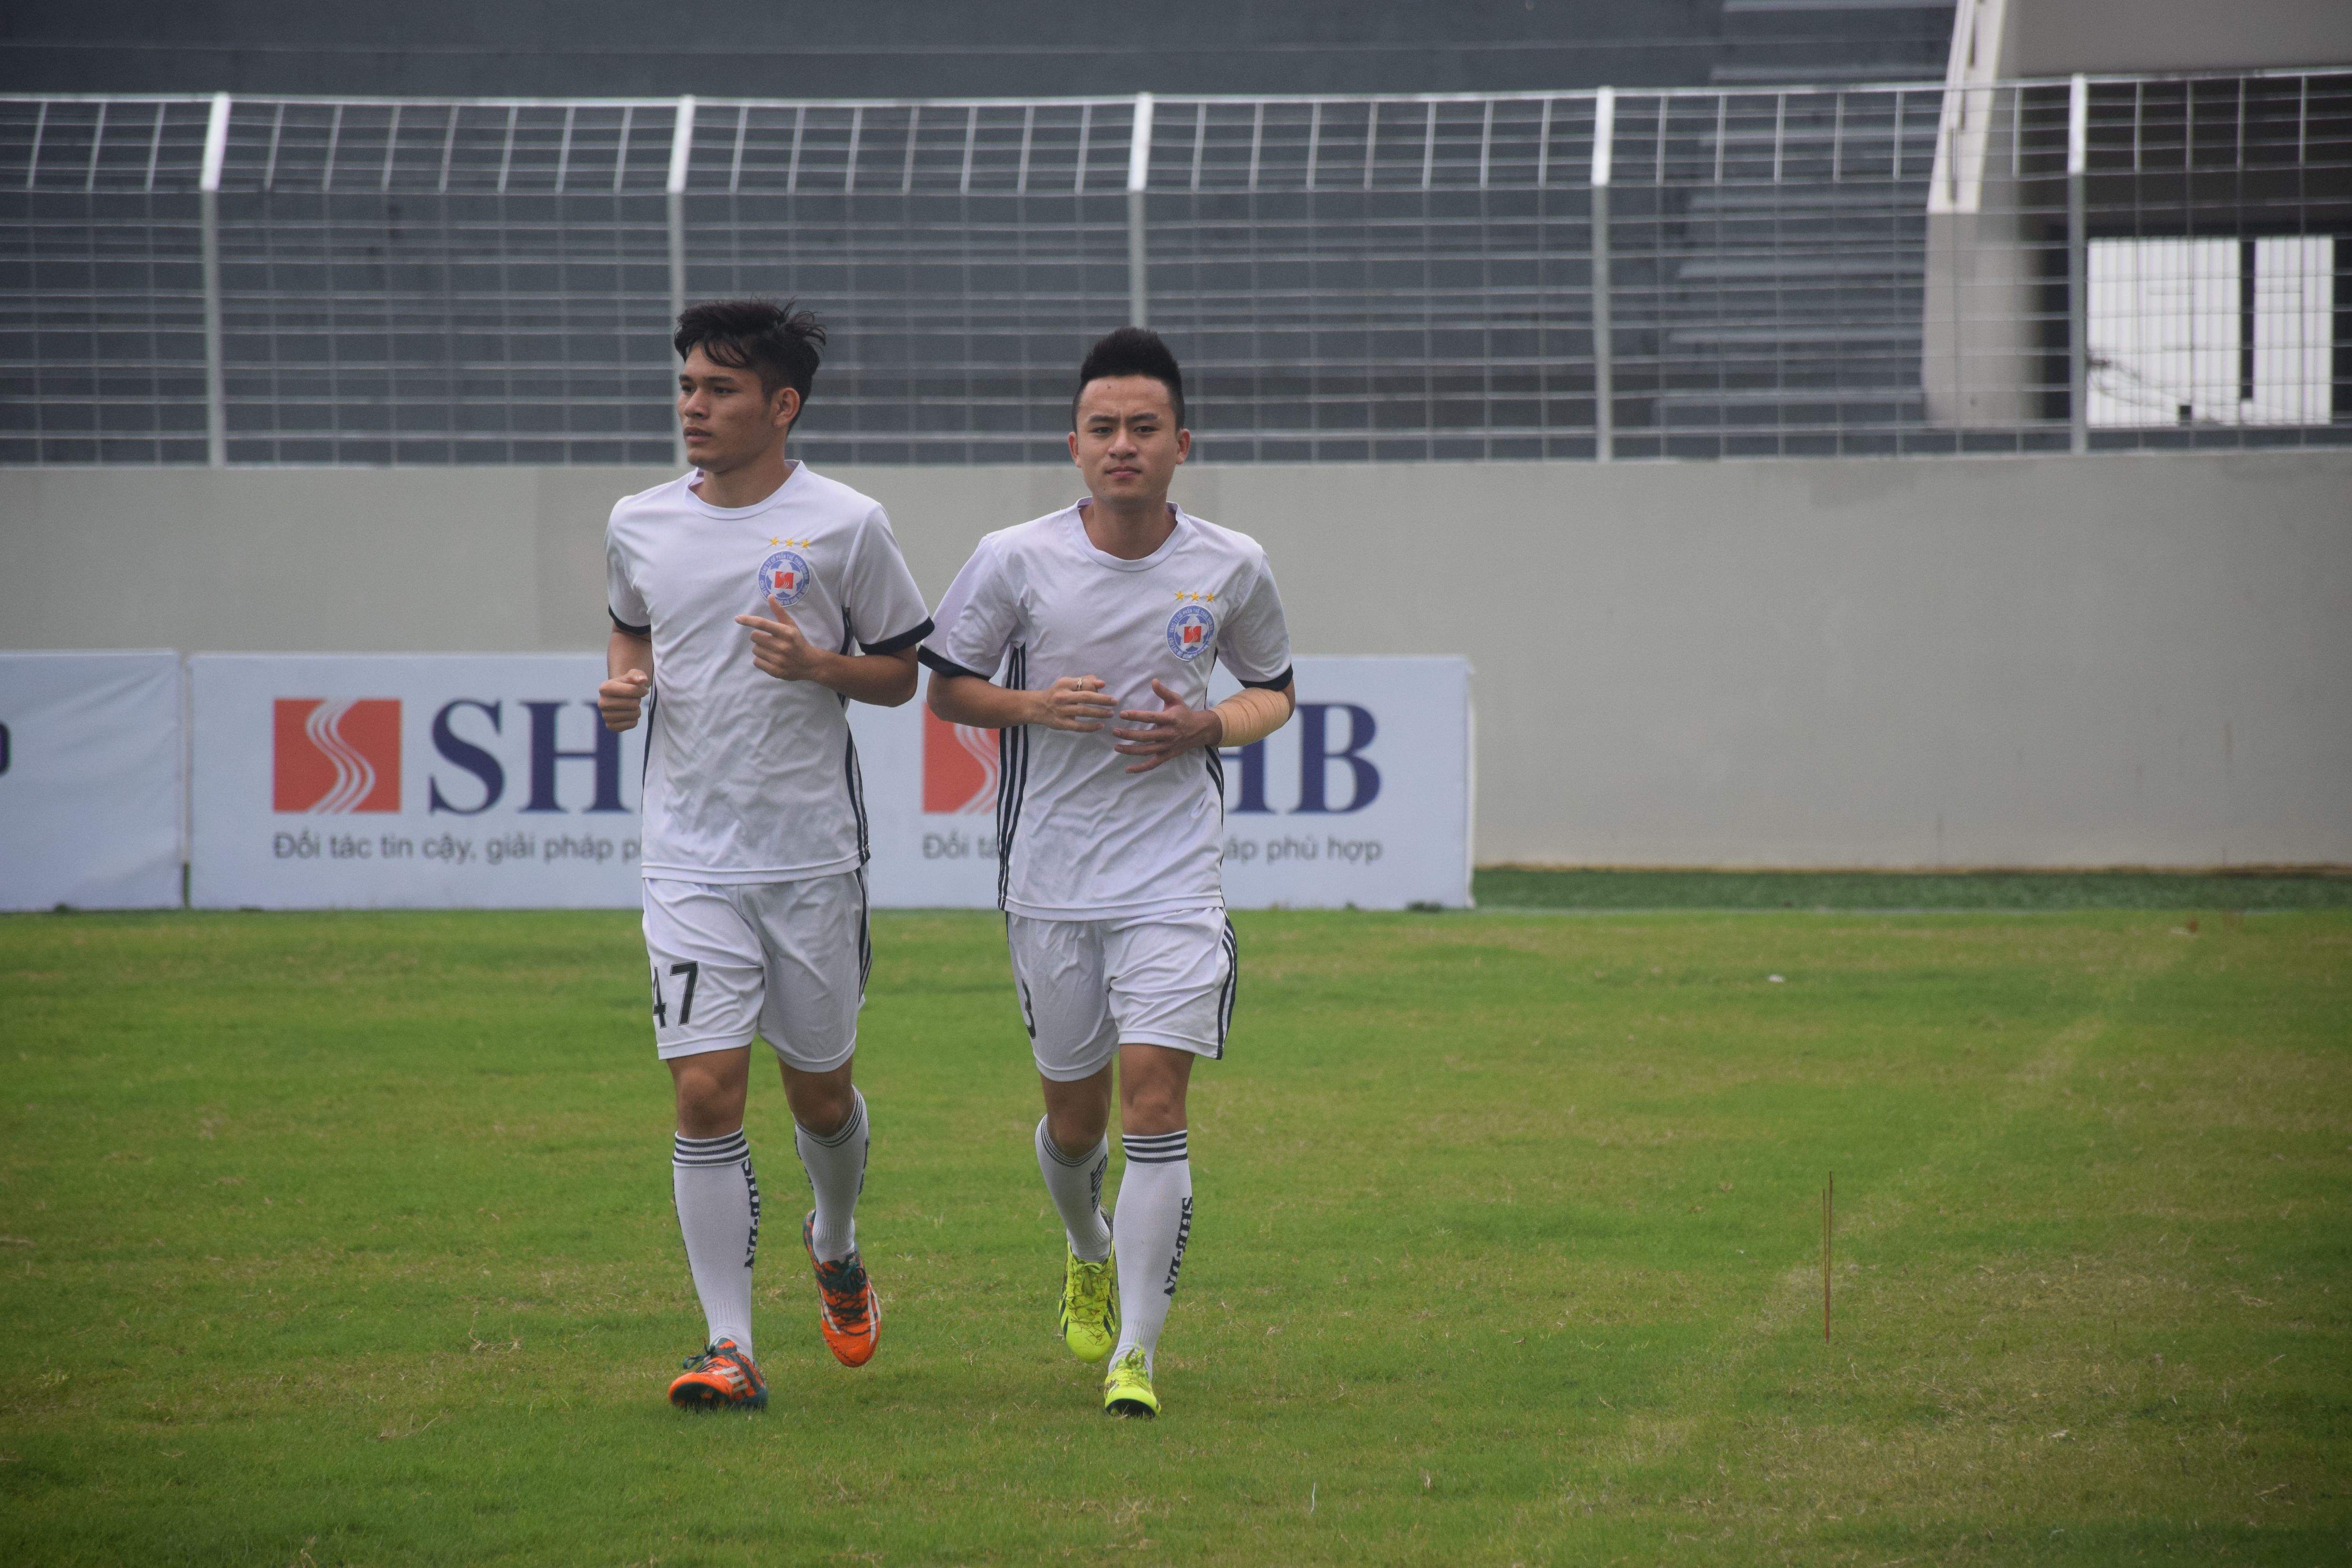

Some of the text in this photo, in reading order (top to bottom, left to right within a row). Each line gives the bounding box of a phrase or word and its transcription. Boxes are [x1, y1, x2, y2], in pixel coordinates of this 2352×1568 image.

[428, 699, 635, 816] SH
[273, 828, 320, 859] Đối
[330, 832, 373, 859] tác
[380, 832, 414, 859] tin
[423, 831, 477, 865] cậy,
[486, 831, 534, 865] giải
[544, 833, 614, 864] pháp
[923, 828, 969, 860] Đối
[1267, 834, 1317, 865] phù
[1327, 834, 1383, 865] hợp
[653, 961, 699, 1028] 47
